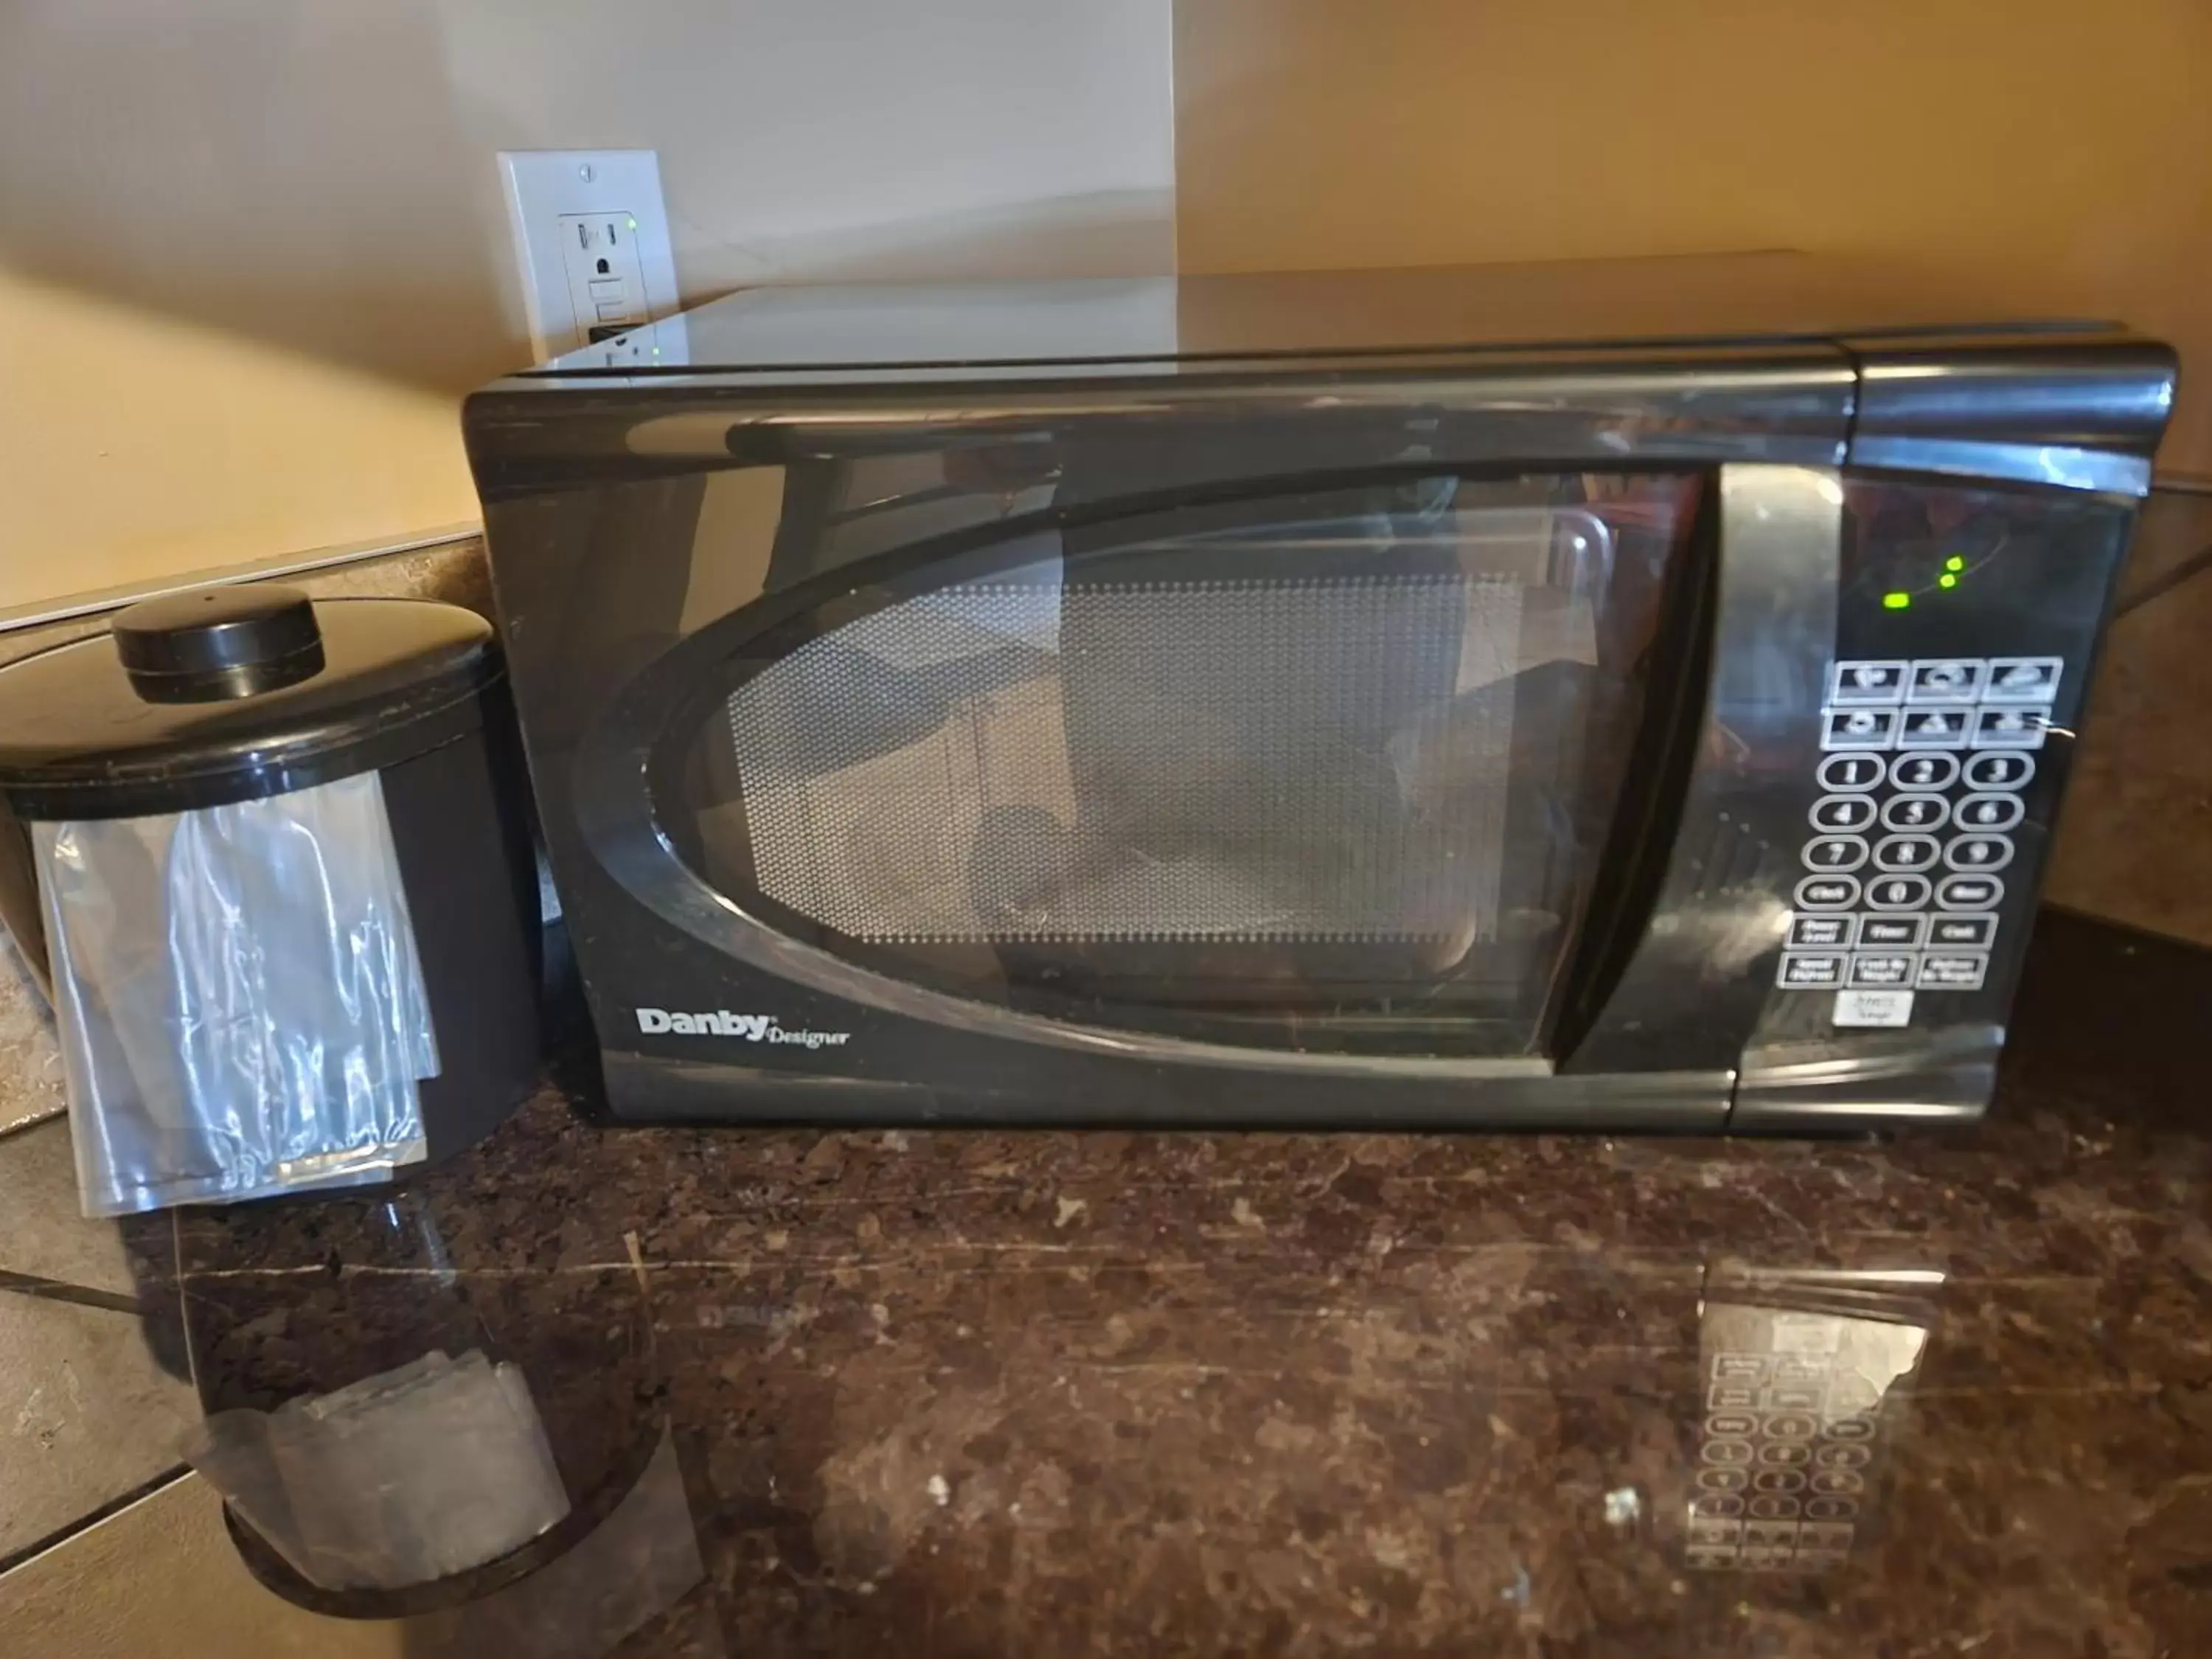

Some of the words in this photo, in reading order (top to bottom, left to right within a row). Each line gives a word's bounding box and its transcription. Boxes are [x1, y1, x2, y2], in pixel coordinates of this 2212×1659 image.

[1845, 760, 1857, 784] 1
[1913, 760, 1933, 783] 2
[1988, 759, 2007, 783] 3
[1834, 803, 1851, 824] 4
[1905, 801, 1924, 824] 5
[1829, 843, 1846, 864] 7
[636, 1008, 769, 1041] Danby
[768, 1026, 849, 1048] Designer
